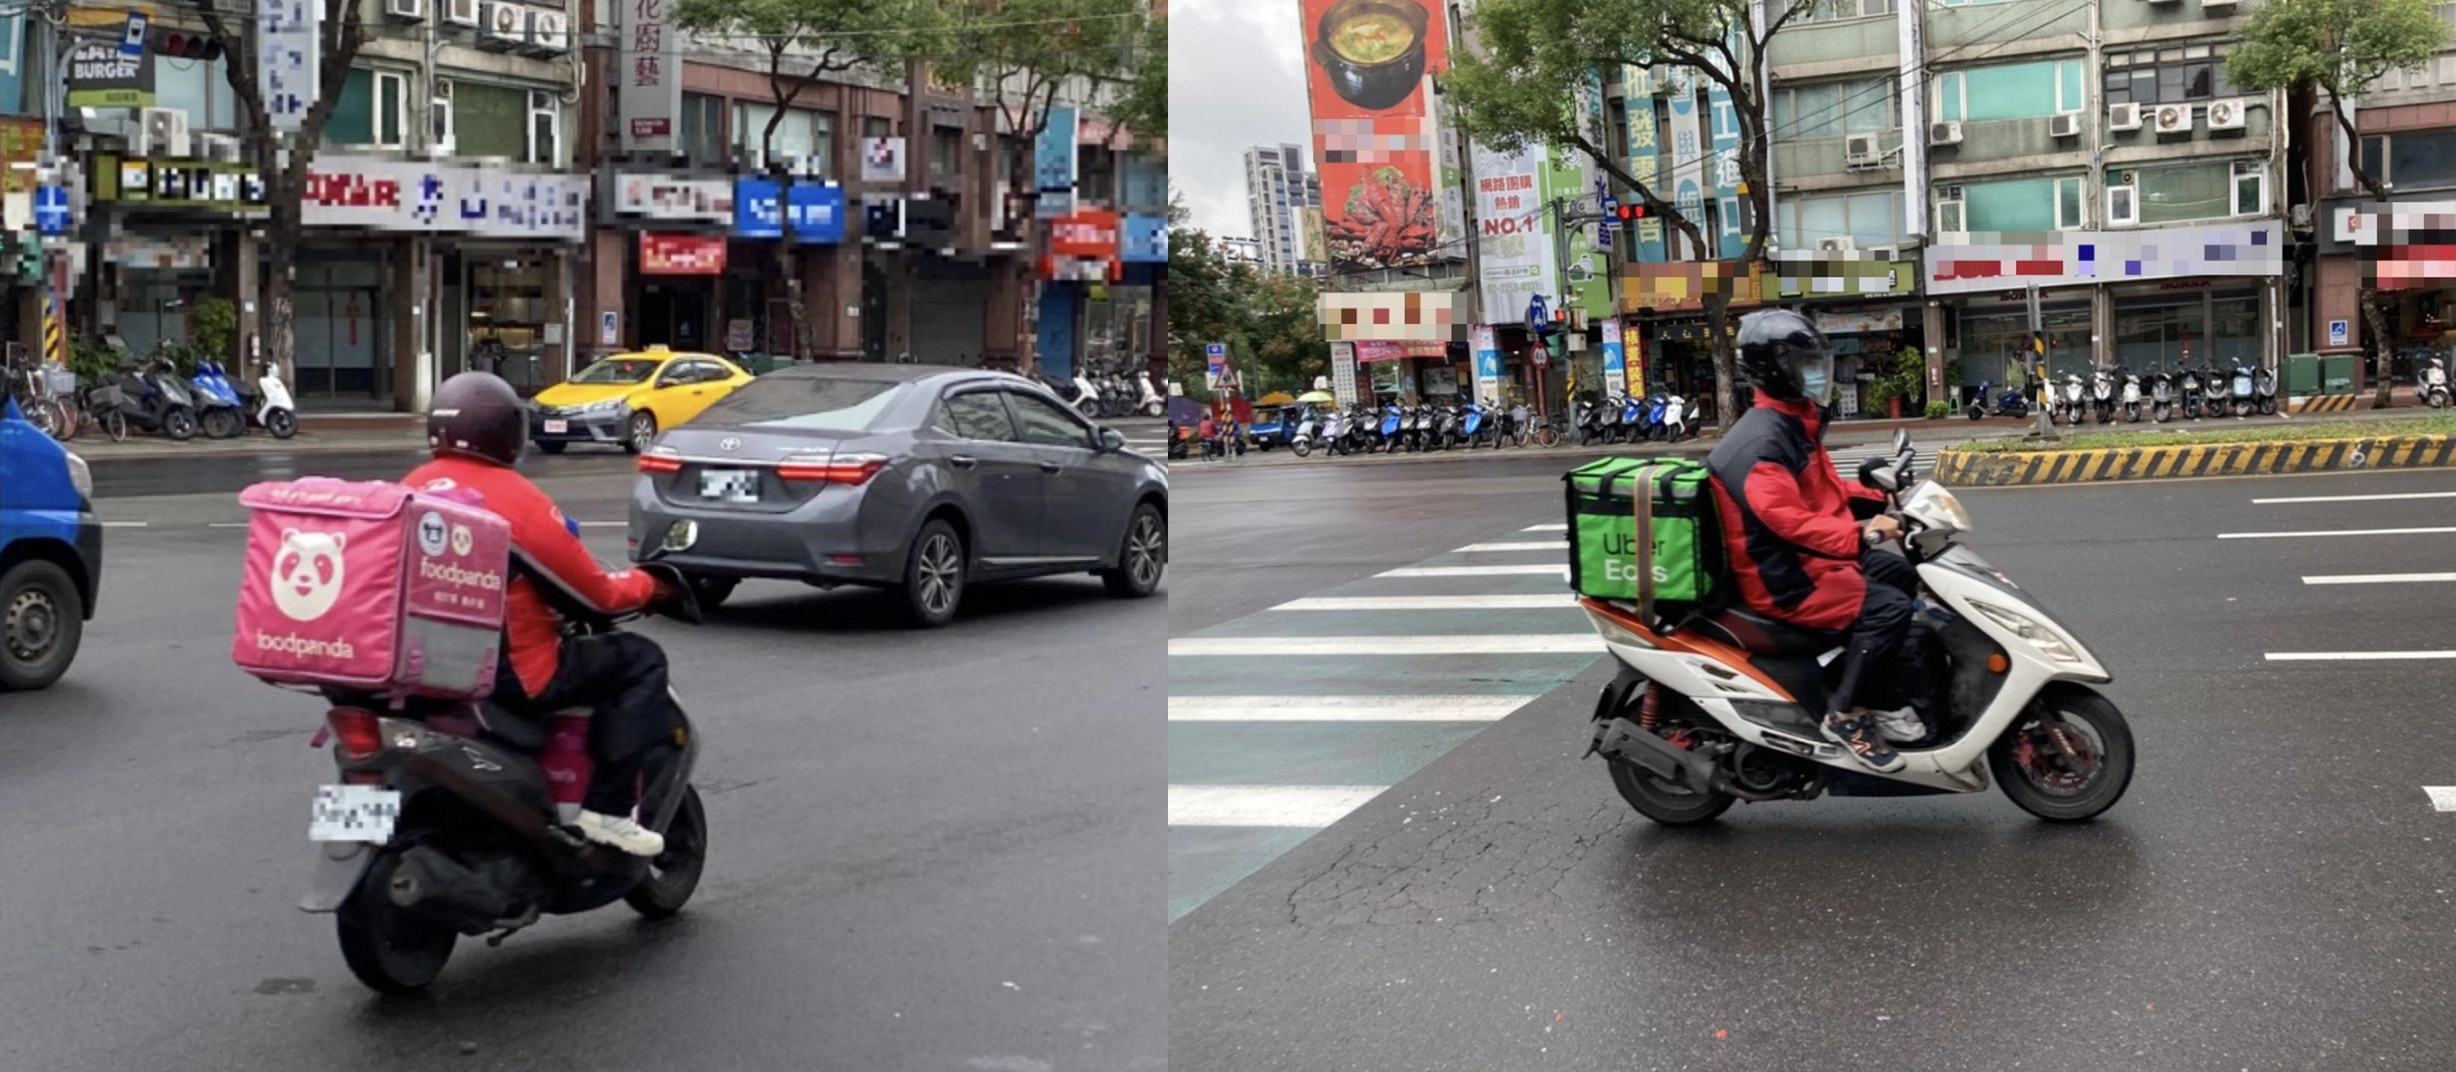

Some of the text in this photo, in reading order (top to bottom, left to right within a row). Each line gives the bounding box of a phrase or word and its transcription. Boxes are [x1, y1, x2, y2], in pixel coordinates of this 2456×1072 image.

[75, 62, 136, 79] BURGER
[1484, 215, 1533, 236] NO.1
[421, 556, 501, 591] foodpanda
[1604, 559, 1668, 583] Eas
[257, 628, 353, 659] foodpanda
